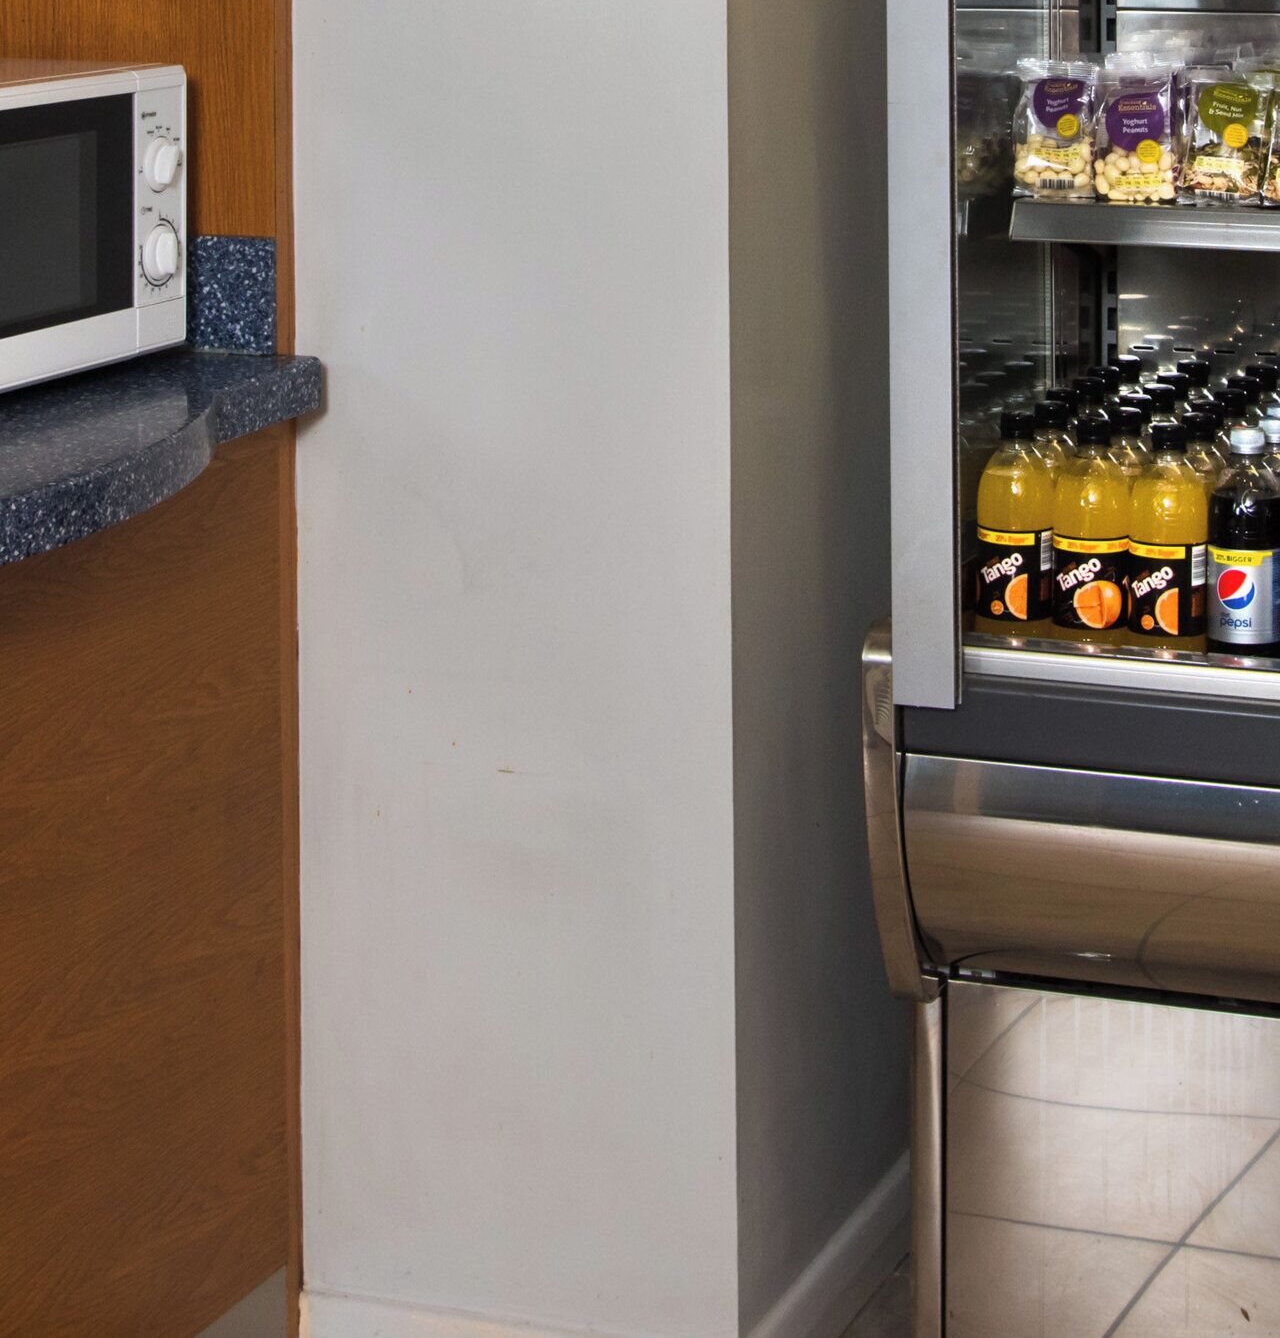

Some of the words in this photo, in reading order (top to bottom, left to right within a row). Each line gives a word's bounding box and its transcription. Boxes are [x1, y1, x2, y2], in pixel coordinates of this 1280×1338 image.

[1122, 118, 1148, 127] Yoghurt
[981, 552, 1023, 584] Tango
[1056, 558, 1102, 591] Tango
[1131, 566, 1175, 598] Tango
[1220, 618, 1252, 629] pepsi
